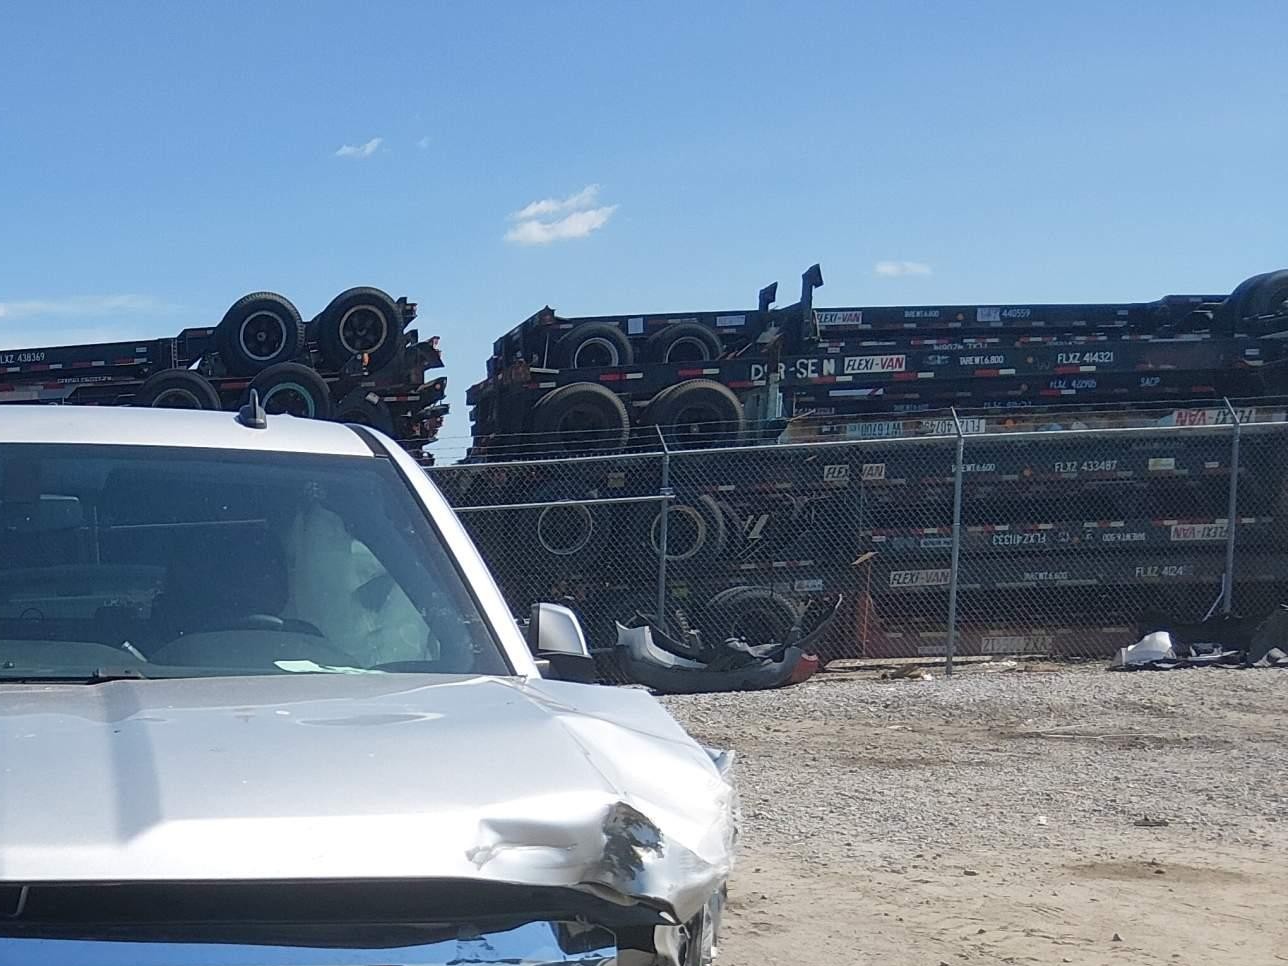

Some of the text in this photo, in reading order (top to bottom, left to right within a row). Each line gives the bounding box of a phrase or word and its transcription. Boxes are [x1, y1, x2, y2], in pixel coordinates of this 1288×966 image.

[17, 352, 45, 362] 438369
[1057, 352, 1114, 364] FLXZ 414321
[846, 357, 904, 371] FLEXI-VAN
